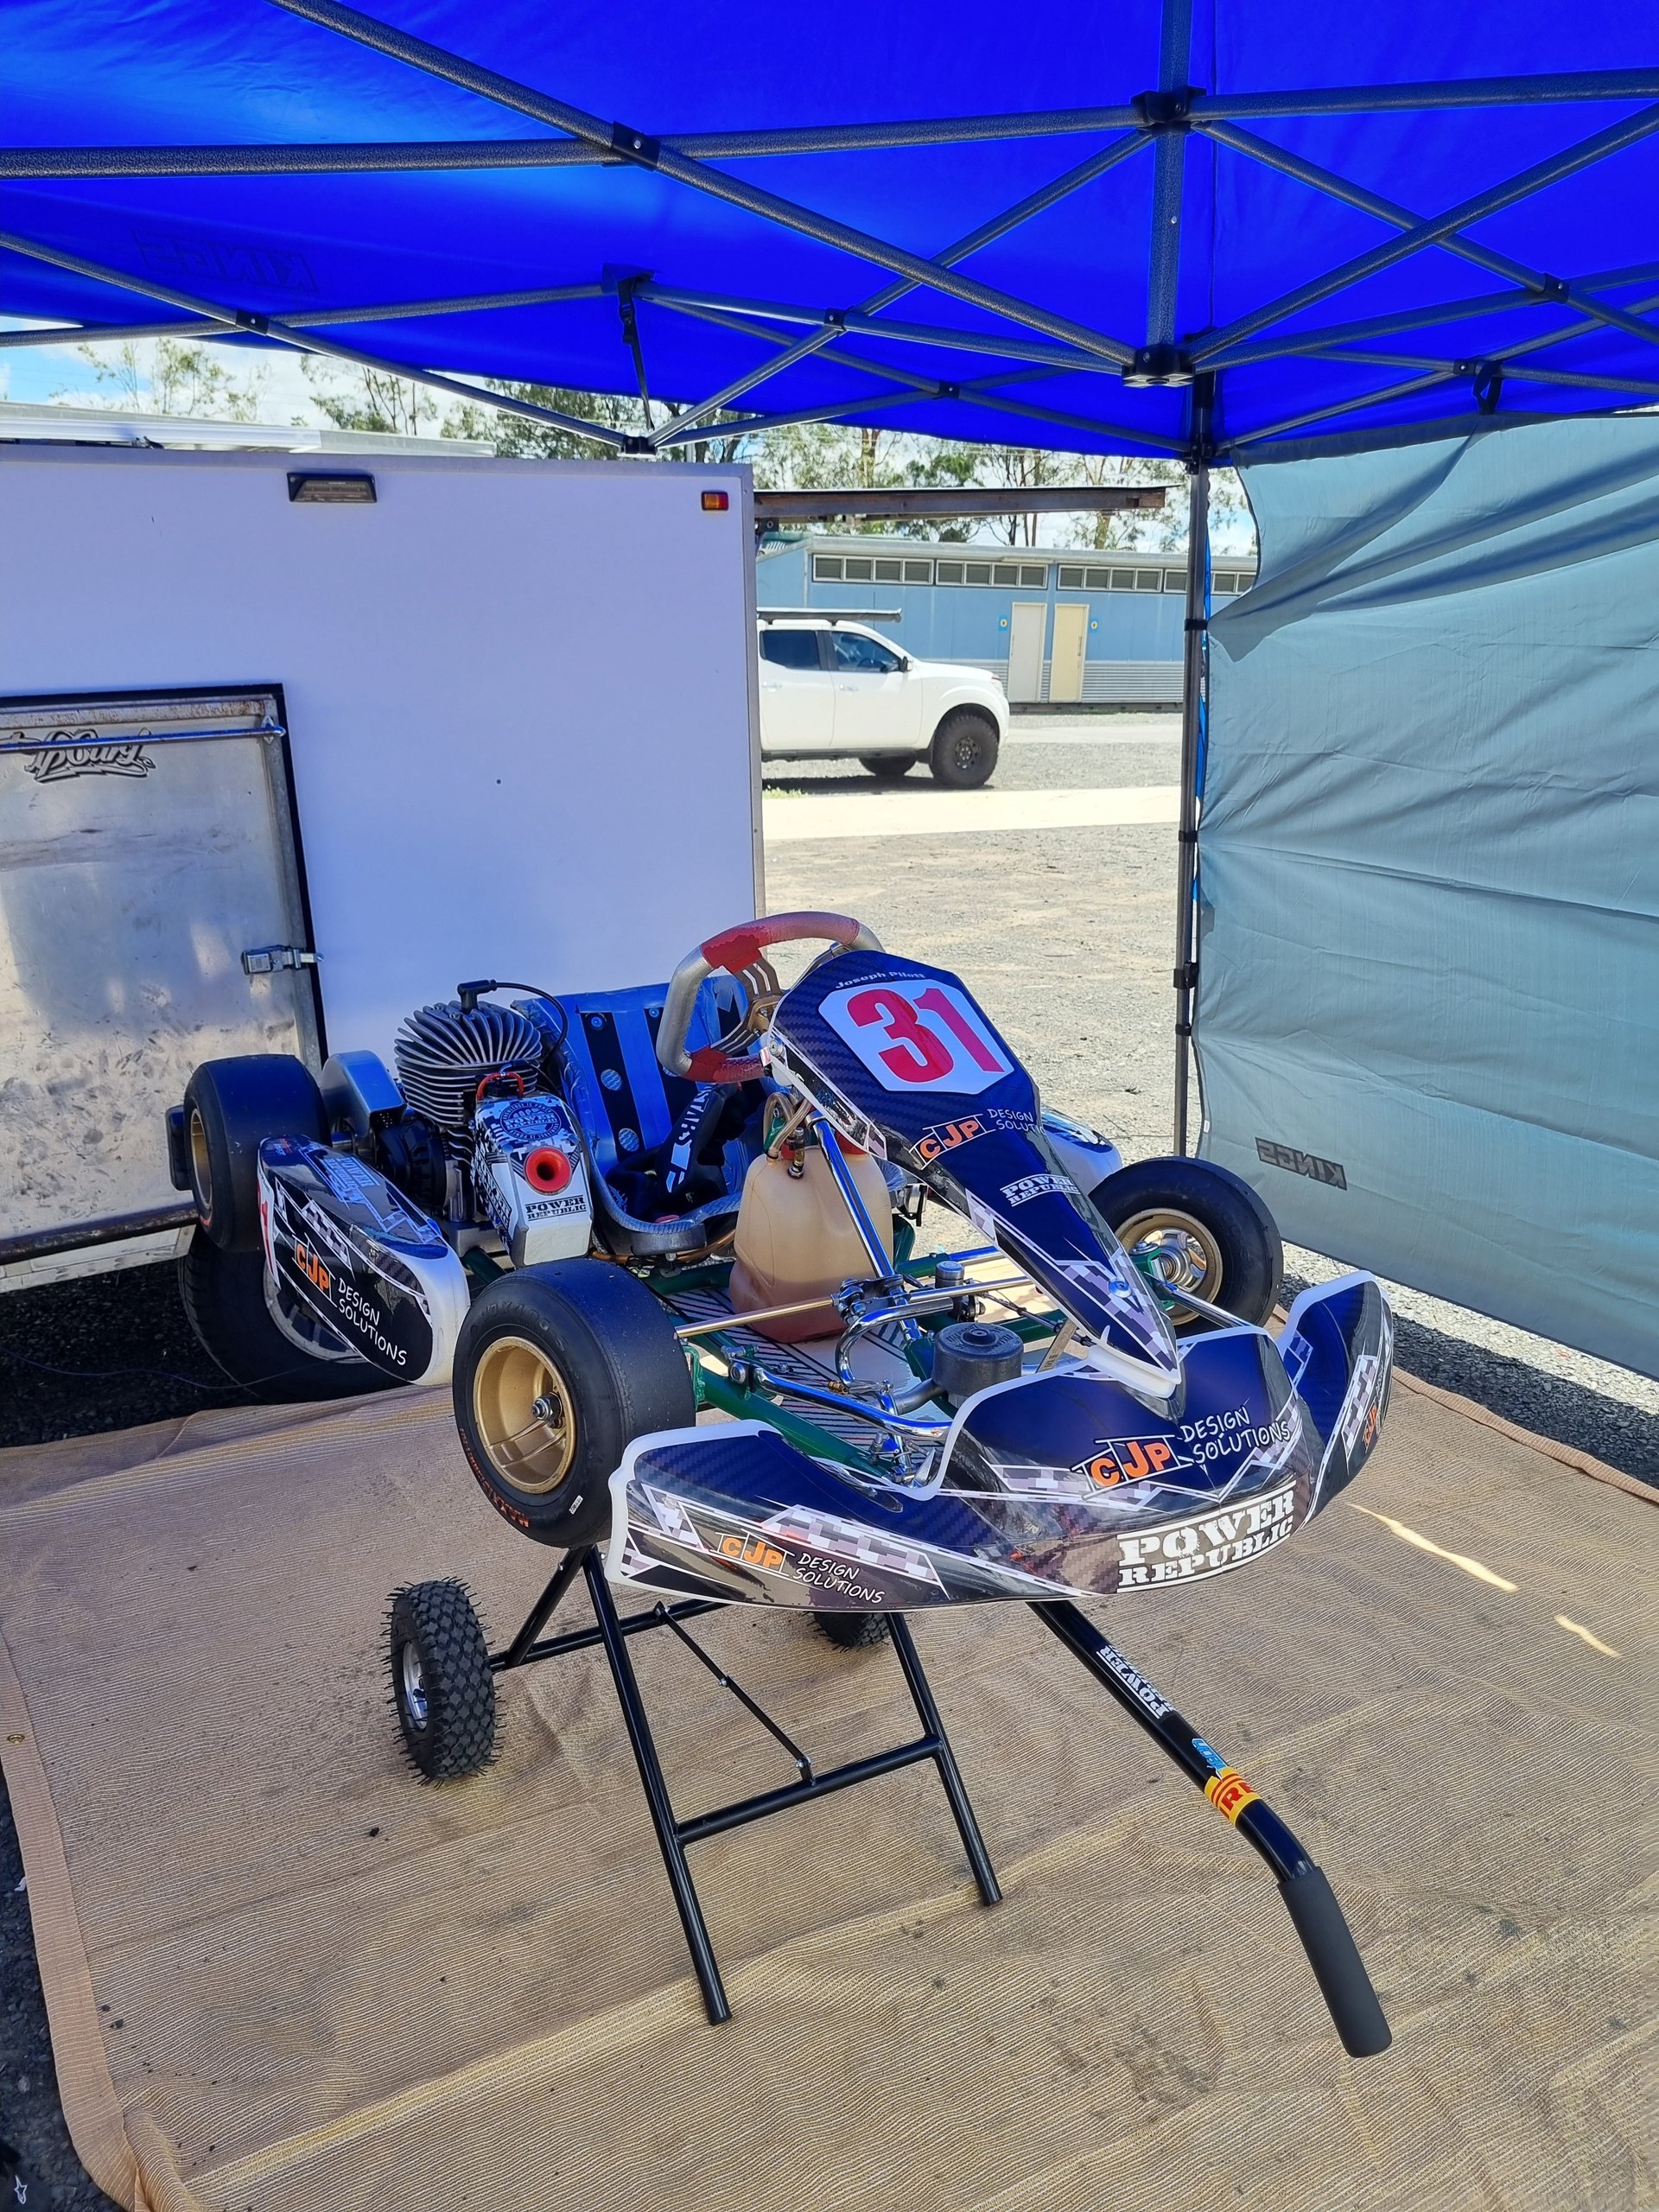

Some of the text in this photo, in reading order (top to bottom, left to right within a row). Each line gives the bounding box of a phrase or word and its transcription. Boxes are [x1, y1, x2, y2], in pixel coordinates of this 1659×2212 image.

[835, 971, 887, 988] Joseph
[847, 987, 1006, 1084] 31
[986, 1108, 1034, 1123] DESIGN
[918, 1119, 980, 1160] CJP
[525, 1197, 585, 1214] POWER
[1002, 1175, 1075, 1198] POWER
[1007, 1183, 1080, 1205] REPUBLIC
[526, 1204, 587, 1219] REPUBLIC
[296, 1243, 329, 1291] CJP
[338, 1277, 380, 1326] DESIGN
[339, 1298, 408, 1366] SOLUTIONS
[1179, 1406, 1250, 1443] DESIGN
[1192, 1420, 1291, 1465] SOLUTIONS
[1090, 1440, 1171, 1487] CJP
[1118, 1490, 1294, 1567] POWER
[721, 1536, 784, 1568] CJP
[798, 1552, 861, 1580] DESIGN
[1118, 1515, 1294, 1586] REPUBLIC
[792, 1567, 886, 1604] SOLUTIONS
[1099, 1645, 1171, 1717] POWER
